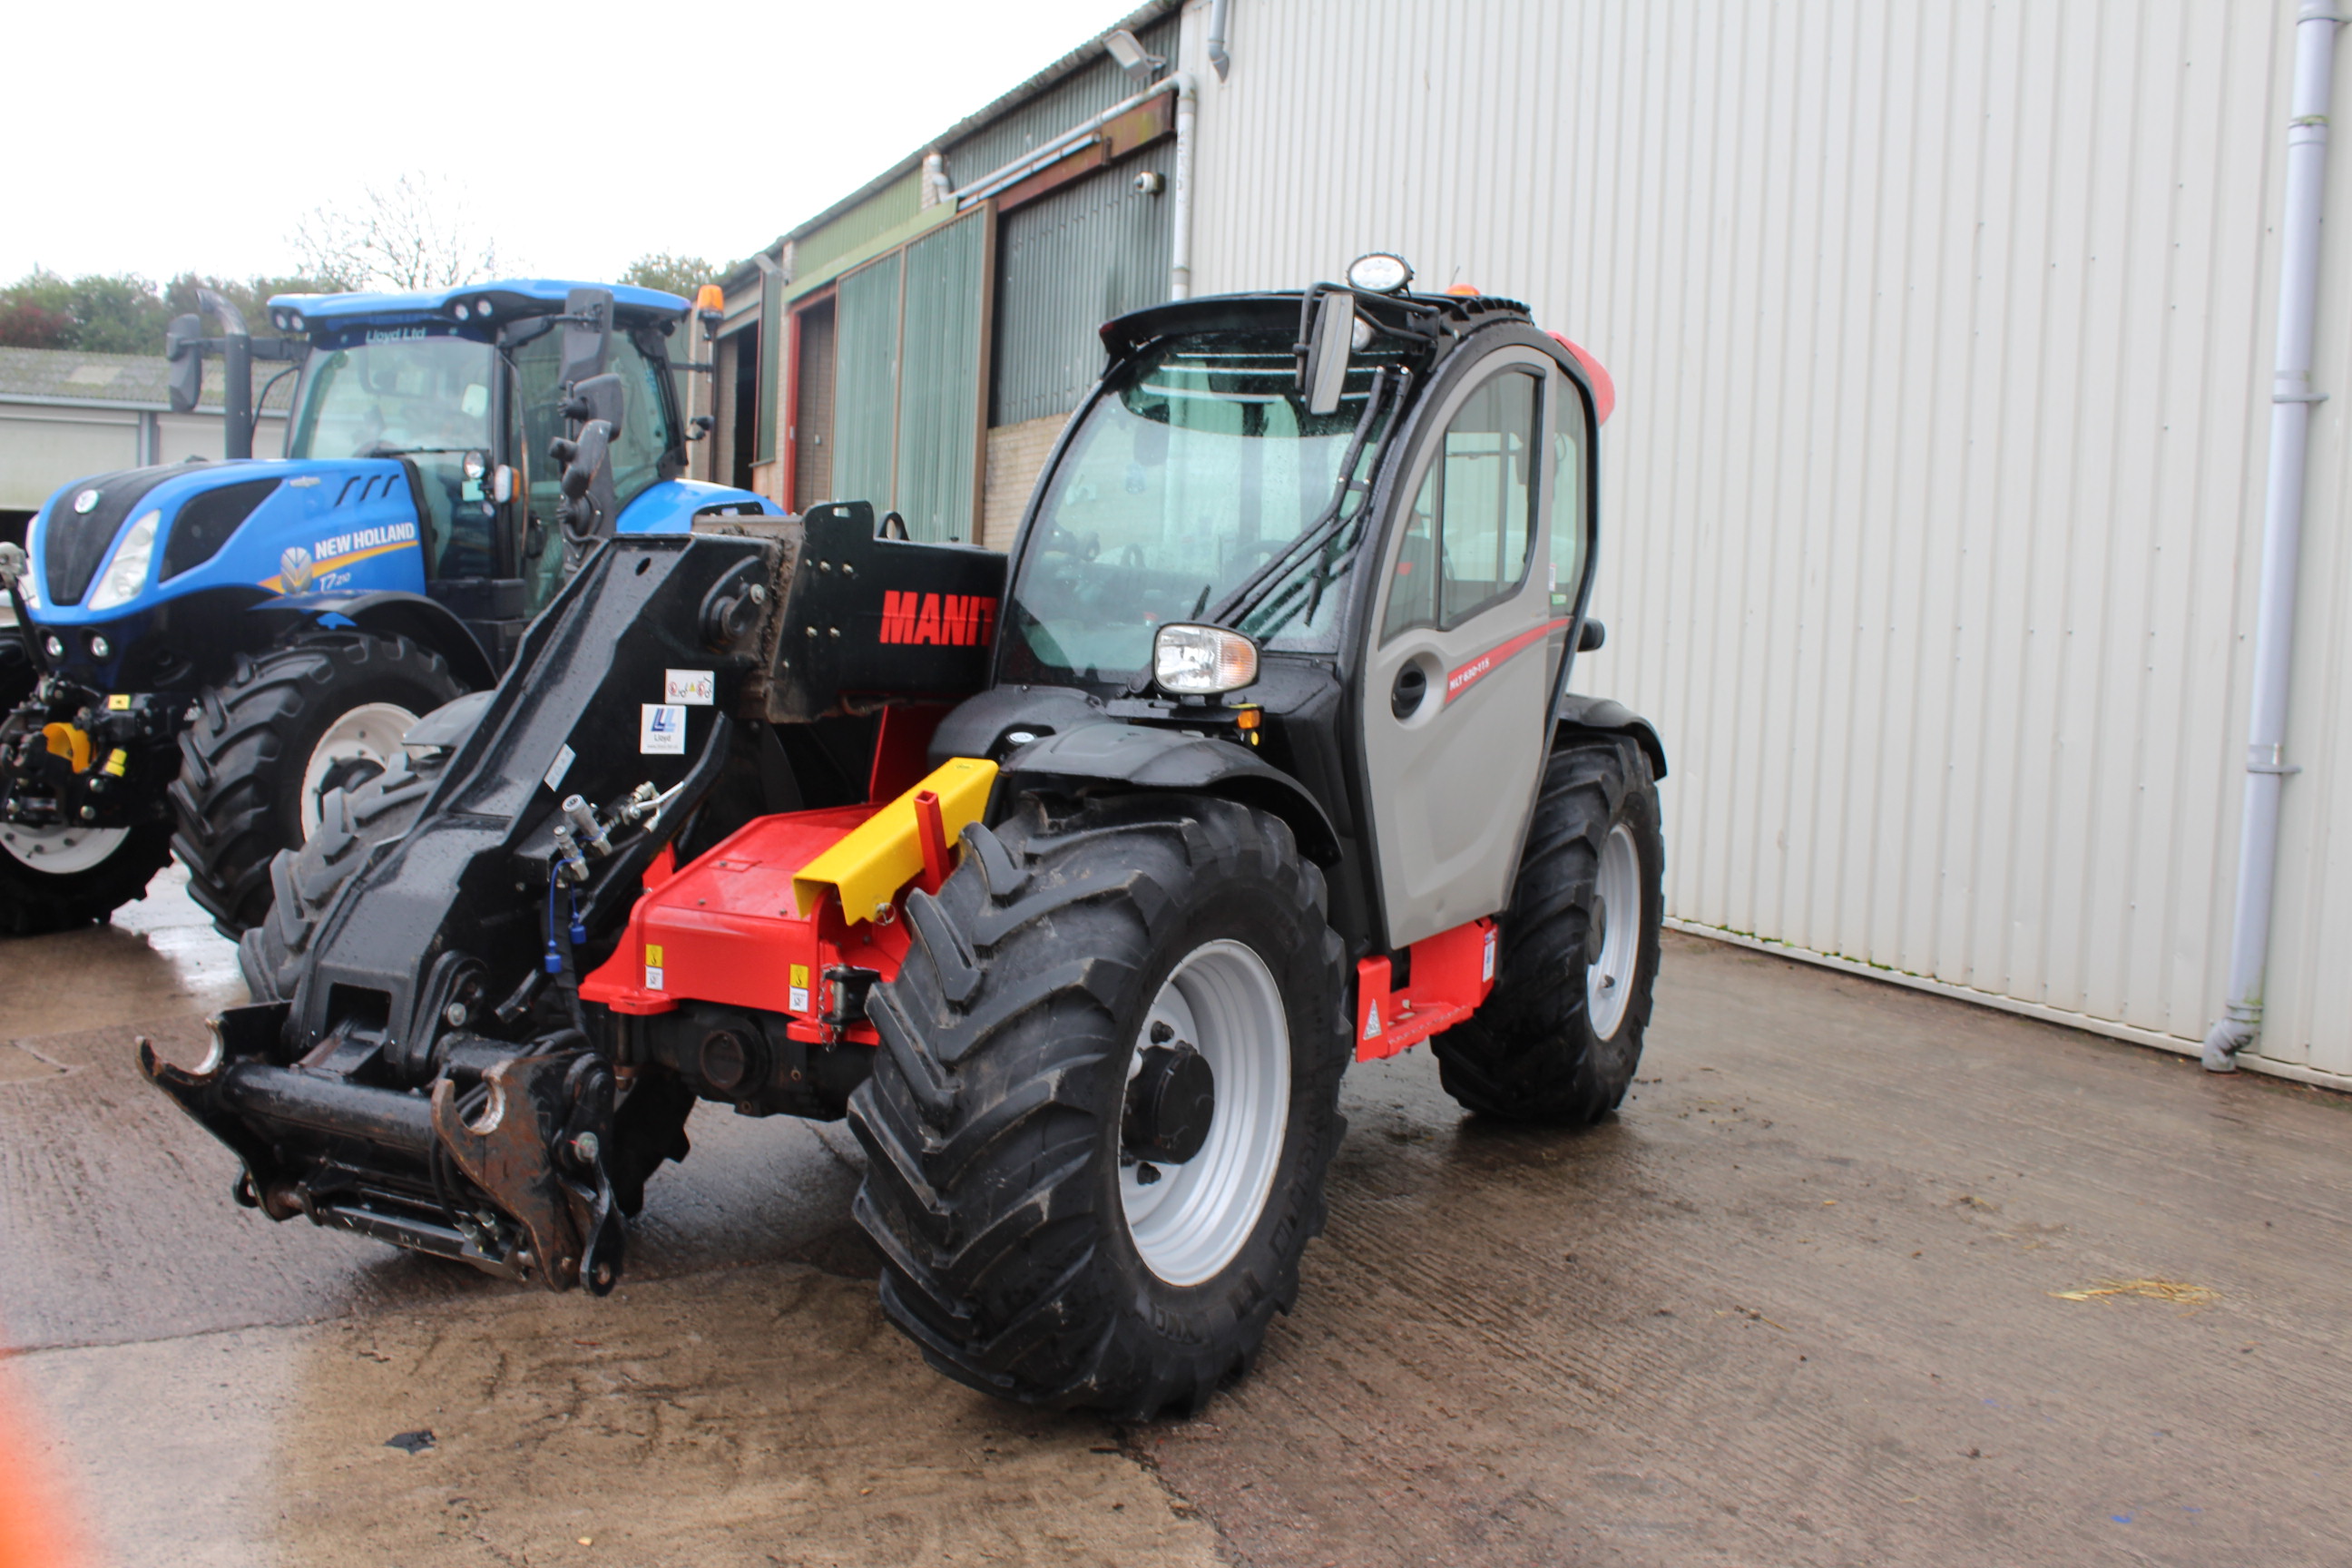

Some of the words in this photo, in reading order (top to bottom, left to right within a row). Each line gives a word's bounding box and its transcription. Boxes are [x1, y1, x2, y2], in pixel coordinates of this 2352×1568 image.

[366, 329, 401, 345] Lloyd
[403, 327, 426, 341] Ltd
[315, 534, 351, 560] NEW
[352, 522, 416, 550] HOLLAND
[879, 590, 997, 646] MANIT
[653, 734, 671, 743] Lloyd
